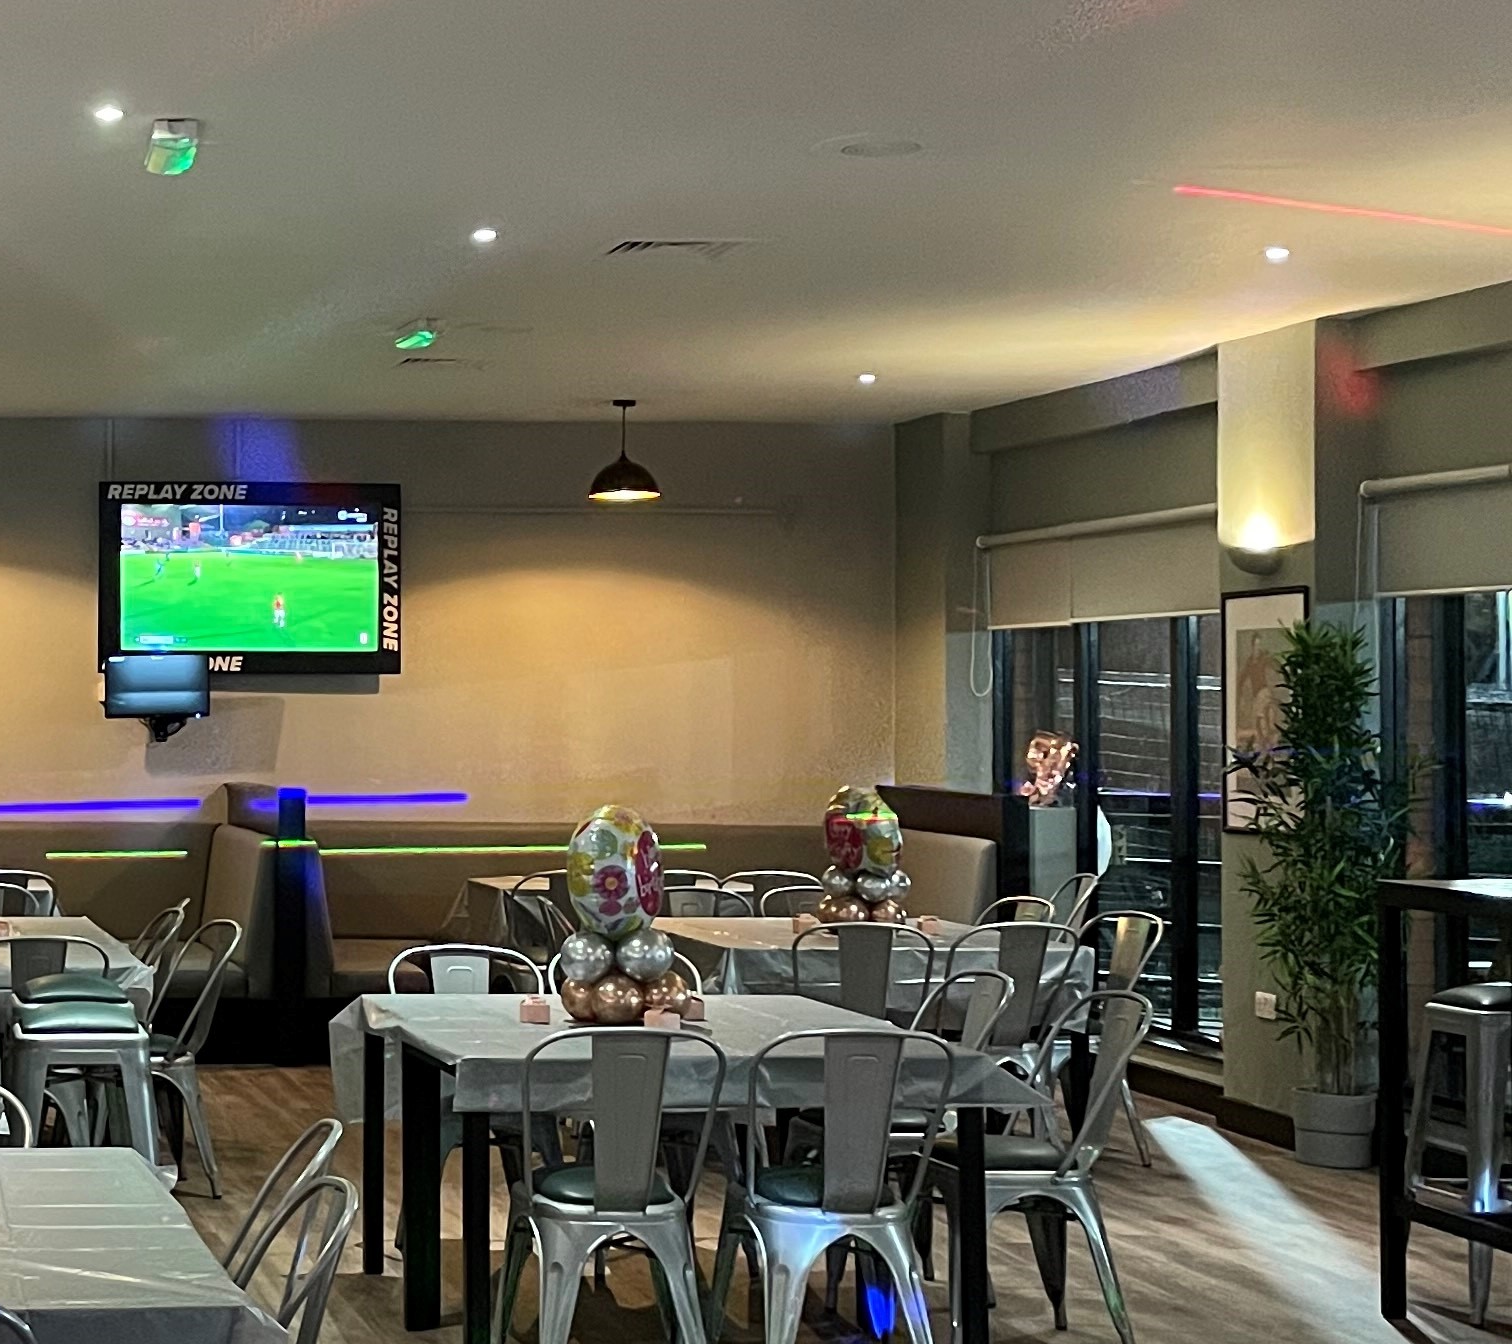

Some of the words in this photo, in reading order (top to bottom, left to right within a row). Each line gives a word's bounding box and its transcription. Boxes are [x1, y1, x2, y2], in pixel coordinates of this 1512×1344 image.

[107, 483, 188, 500] REPLAY
[190, 483, 249, 500] ZONE
[382, 506, 399, 589] REPLAY
[382, 592, 399, 653] ZONE
